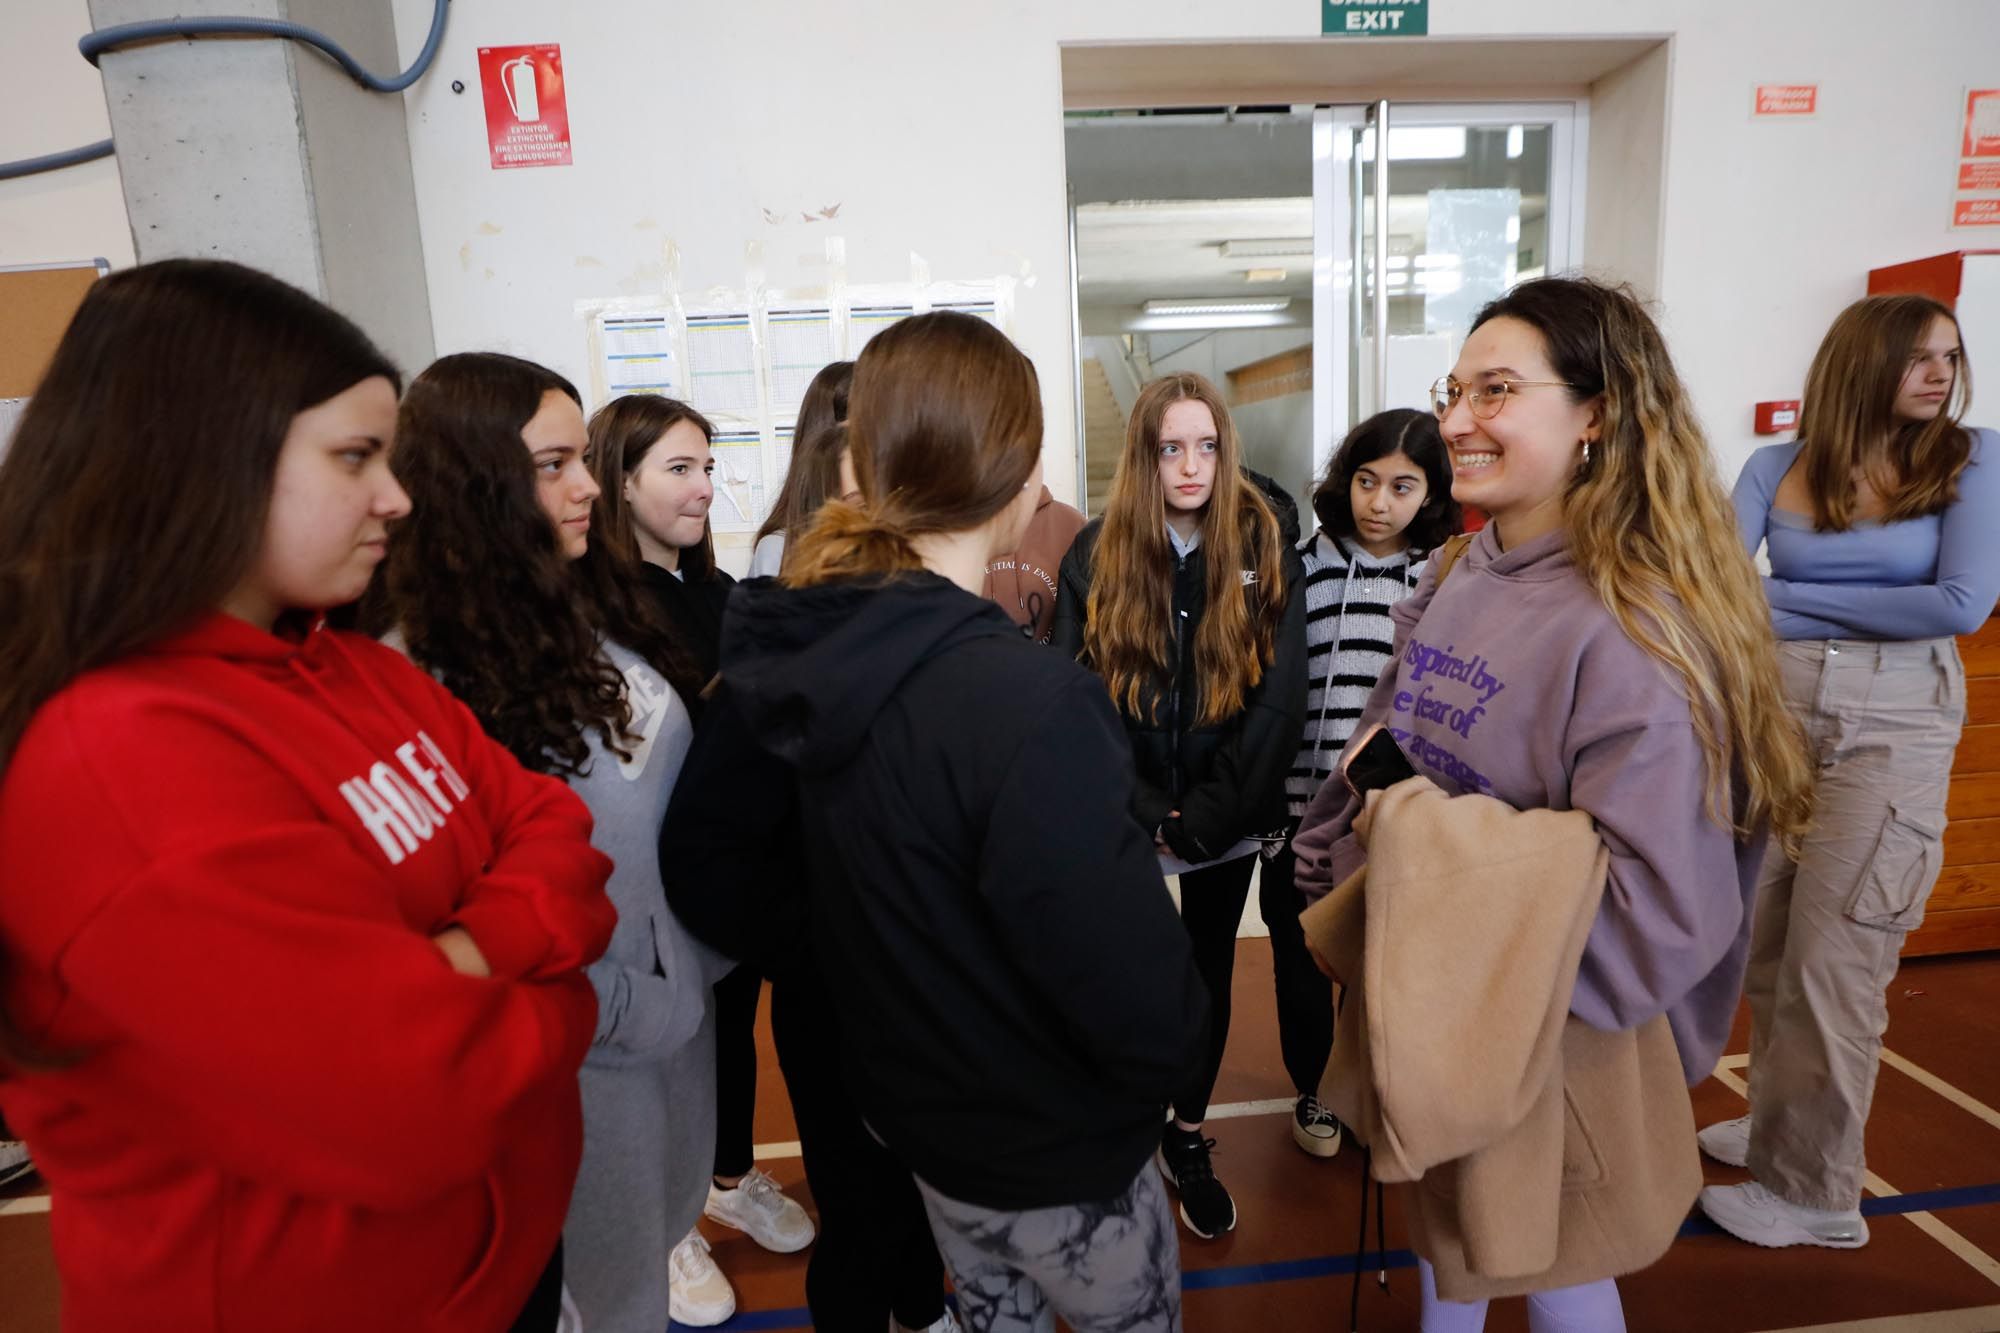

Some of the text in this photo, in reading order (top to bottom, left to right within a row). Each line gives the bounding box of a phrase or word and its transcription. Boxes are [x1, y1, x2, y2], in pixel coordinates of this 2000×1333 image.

[1346, 11, 1404, 30] EXIT
[511, 125, 548, 134] EXTINTOR
[507, 134, 554, 144] EXTINCTEUR
[495, 142, 568, 153] FIRE EXTINGUISHER
[1020, 562, 1032, 572] IS
[1404, 638, 1505, 704] nspired by
[1414, 685, 1453, 725] fear
[1449, 706, 1486, 740] of
